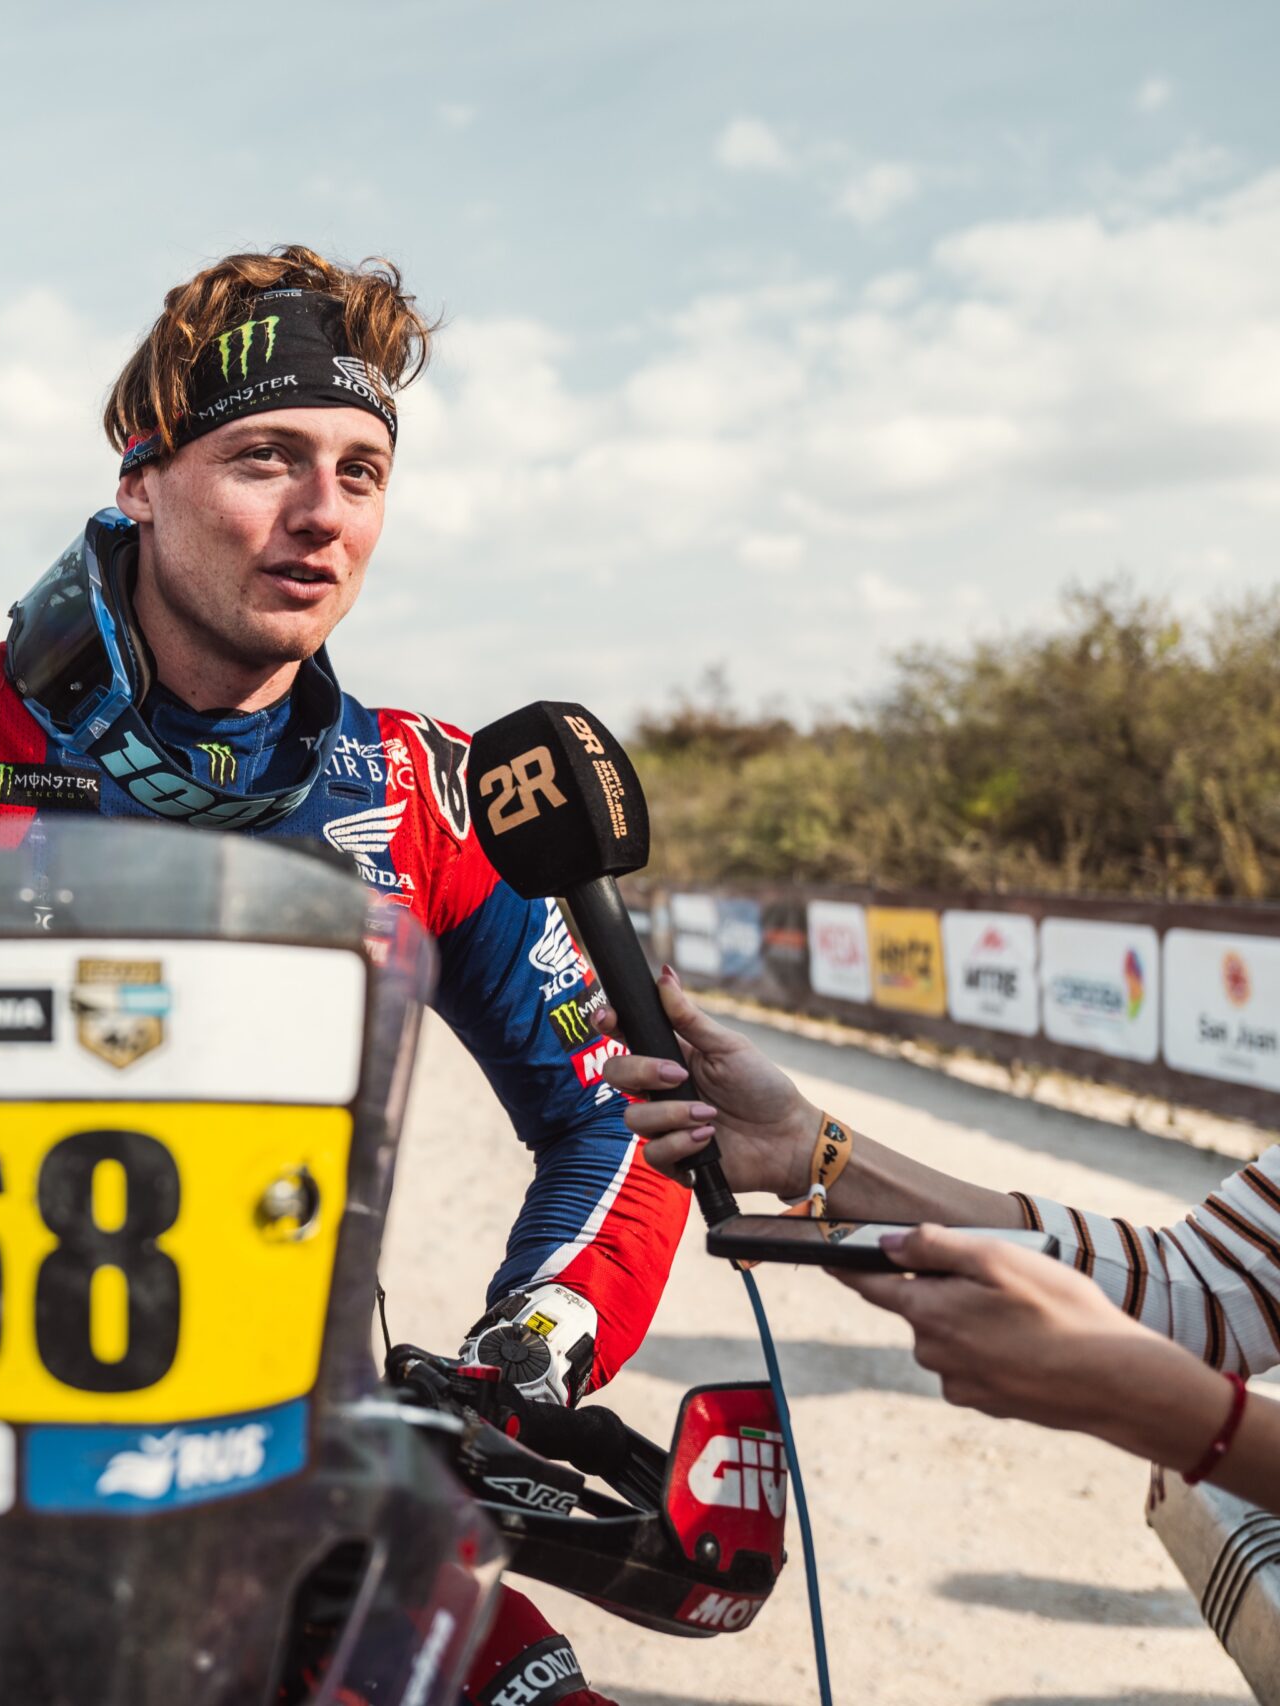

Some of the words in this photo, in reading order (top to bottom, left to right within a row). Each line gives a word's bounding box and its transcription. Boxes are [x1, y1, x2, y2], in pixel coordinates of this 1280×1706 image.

[198, 374, 299, 420] MONSTER
[563, 715, 605, 755] 2R
[14, 772, 98, 792] MONSTER
[324, 754, 362, 779] IR
[606, 760, 625, 797] WORLD
[24, 790, 85, 800] ENERGY
[479, 745, 568, 836] 2R
[592, 760, 621, 840] CHAMPIONSHIP
[599, 760, 628, 837] RALLY-RAID
[355, 862, 416, 891] NDA
[539, 952, 591, 1002] HON
[483, 1476, 578, 1516] ARC
[491, 1648, 581, 1706] HOND
